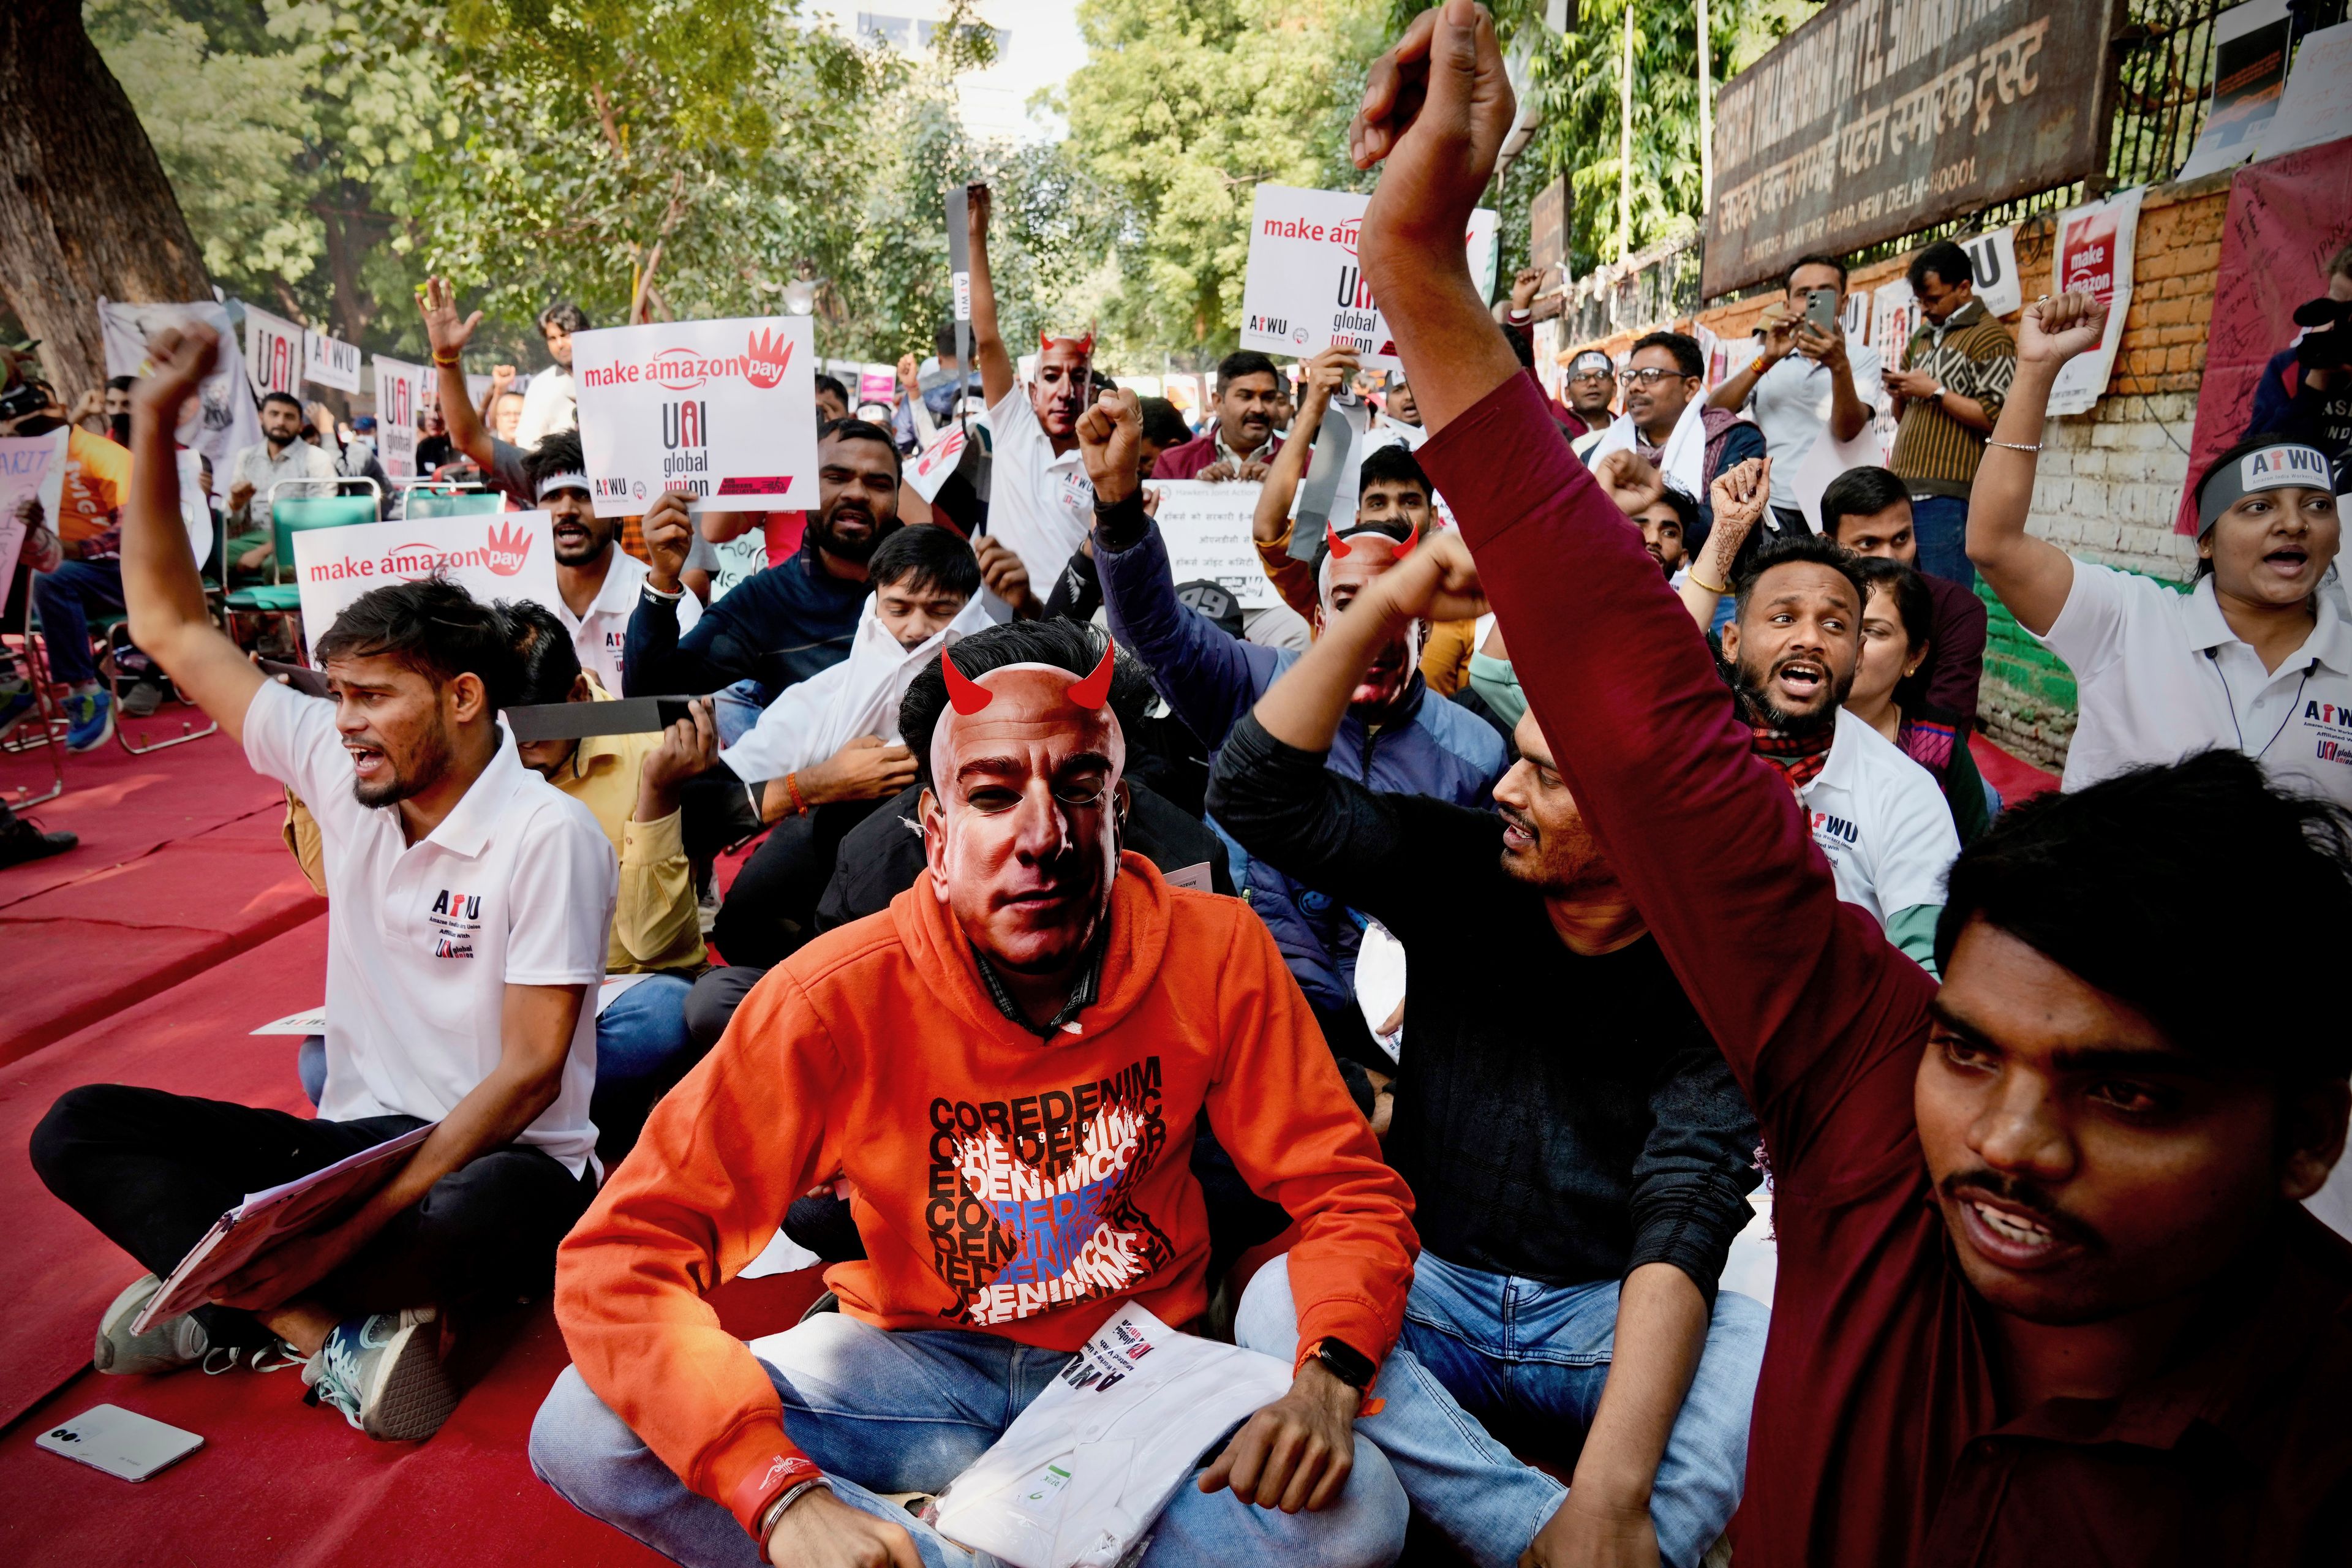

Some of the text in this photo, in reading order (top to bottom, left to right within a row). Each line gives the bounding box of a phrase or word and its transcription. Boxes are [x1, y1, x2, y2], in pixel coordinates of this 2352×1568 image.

[1839, 98, 1891, 178] पटेल
[1264, 217, 1324, 241] make
[2070, 244, 2104, 271] make
[1333, 311, 1377, 333] global
[1331, 332, 1372, 354] union
[585, 356, 783, 388] make amazon pay
[664, 450, 709, 478] global
[665, 475, 709, 497] union
[1191, 511, 1201, 521] को
[309, 549, 524, 582] make amazon pay
[2316, 731, 2345, 741] Affiliated
[1823, 834, 1841, 845] Workers
[1841, 841, 1853, 851] Union
[453, 945, 472, 954] global
